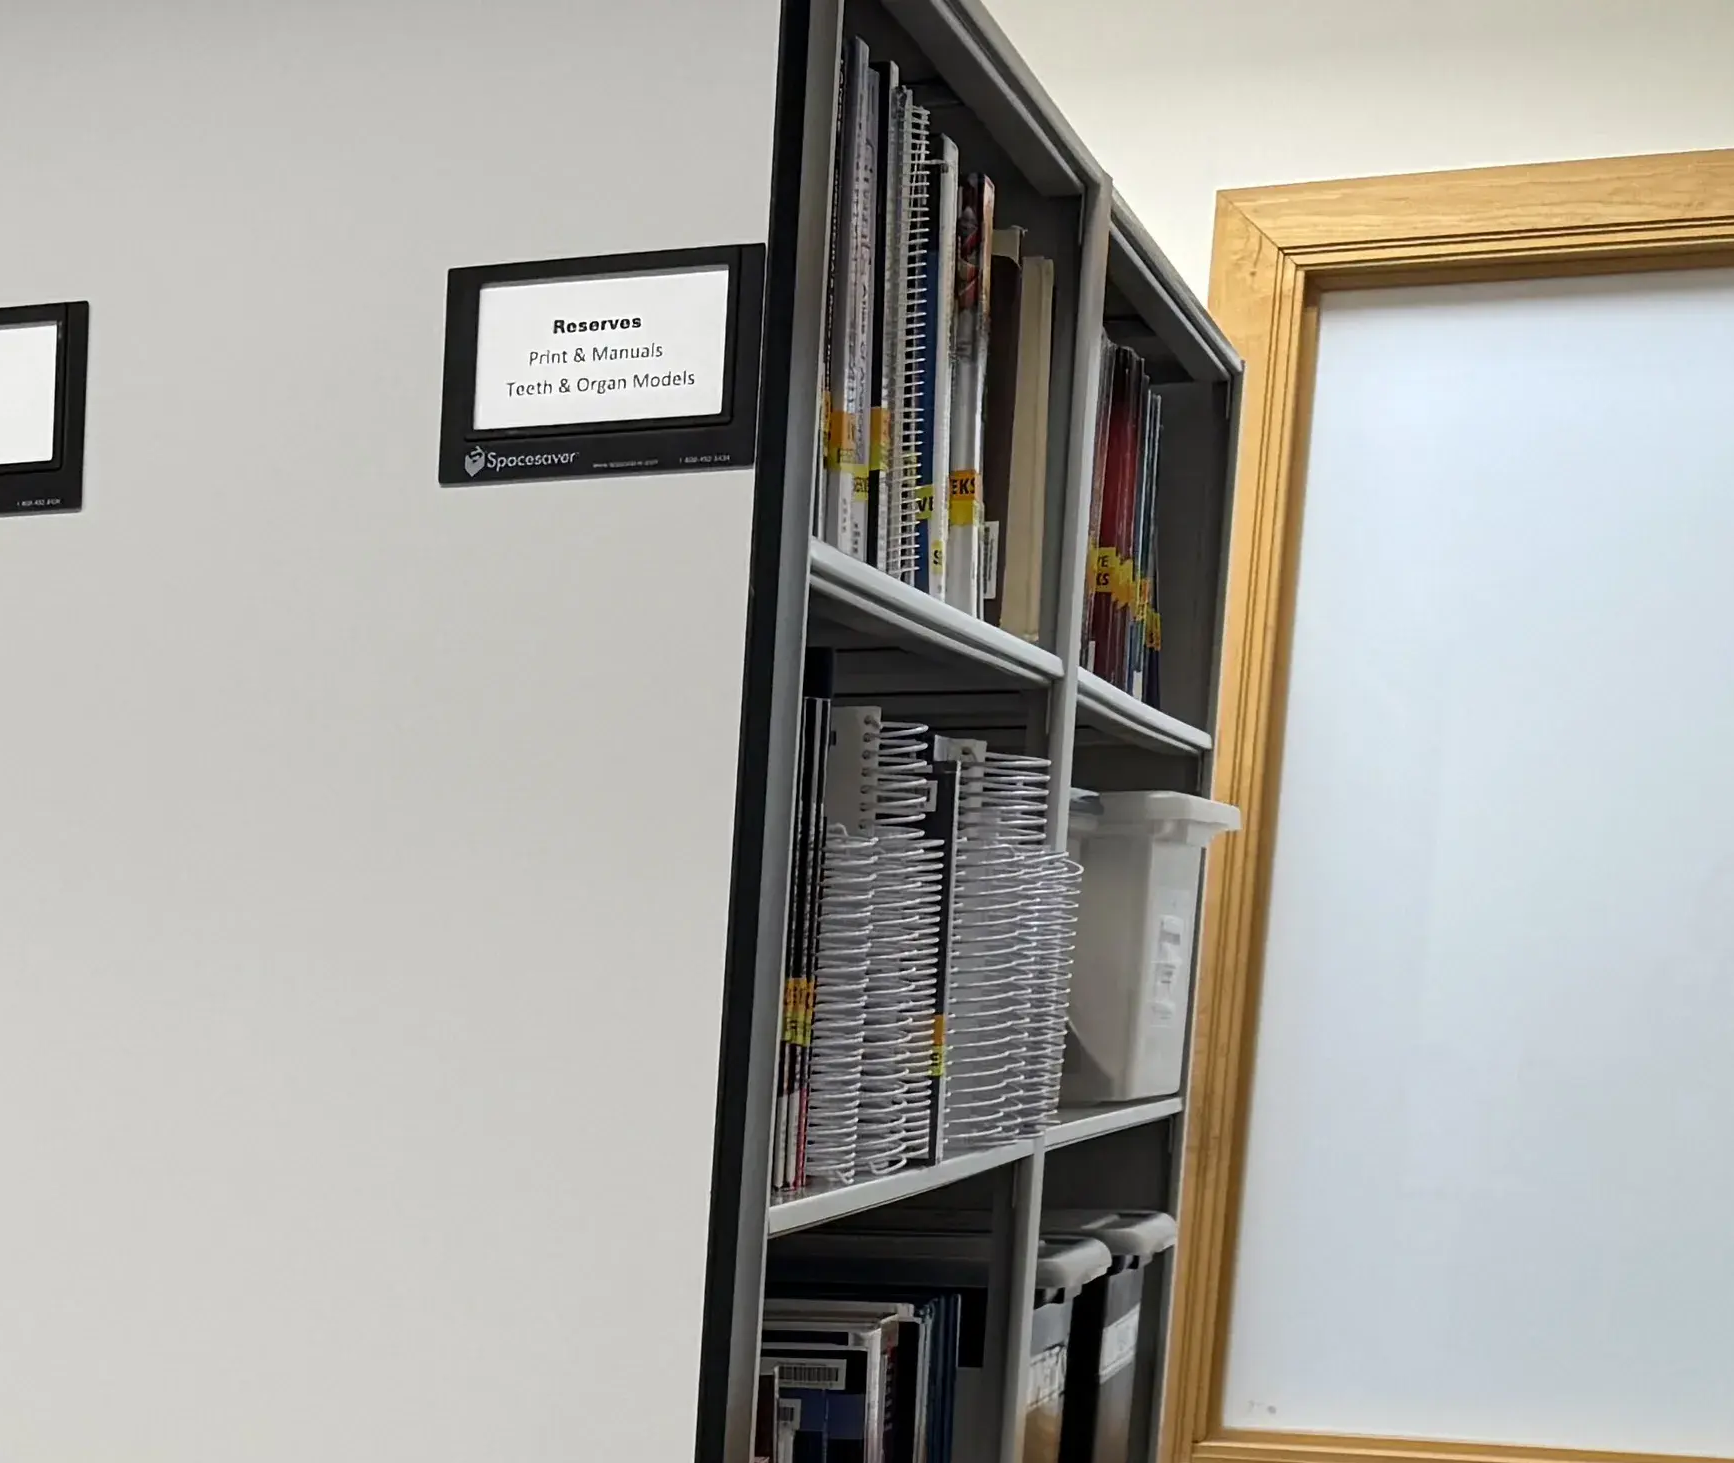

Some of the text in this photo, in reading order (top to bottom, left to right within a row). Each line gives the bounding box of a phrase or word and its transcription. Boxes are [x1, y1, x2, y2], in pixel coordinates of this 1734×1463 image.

[552, 317, 642, 335] Reserves
[529, 343, 664, 366] Print & Manuals
[506, 370, 696, 398] Teeth & Organ Models
[486, 451, 577, 472] Spacesaver
